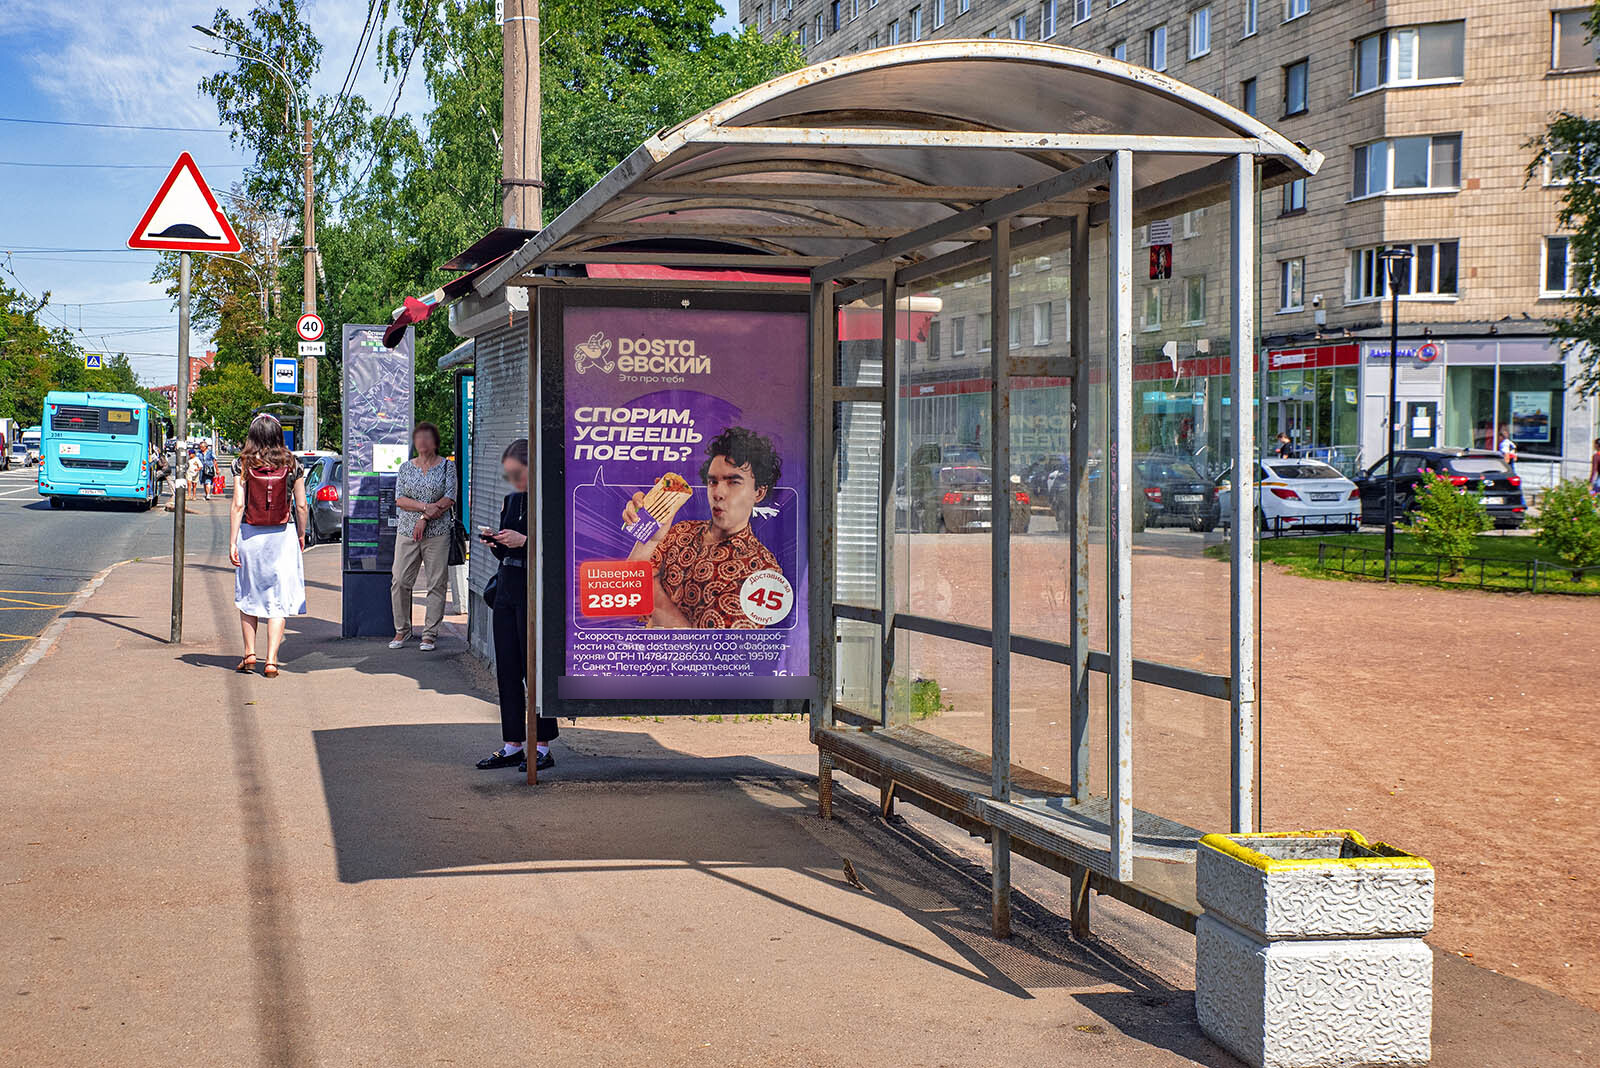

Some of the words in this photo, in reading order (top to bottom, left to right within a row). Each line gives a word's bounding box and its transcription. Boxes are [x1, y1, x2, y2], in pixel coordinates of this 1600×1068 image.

[302, 321, 318, 332] 40
[619, 373, 638, 382] Это
[640, 375, 659, 384] про
[661, 375, 685, 384] тебя
[574, 406, 695, 427] СПОРИМ,
[573, 425, 703, 443] УСПЕЕШЬ
[573, 444, 692, 462] ПОЕСТЬ?
[587, 568, 645, 580] Шаверма
[588, 580, 642, 589] классика
[747, 587, 784, 611] 45
[626, 633, 670, 641] доставки
[672, 633, 710, 641] зависит
[712, 633, 722, 641] от
[745, 632, 787, 642] подроб-
[573, 643, 602, 651] ности
[603, 643, 615, 651] на
[617, 642, 645, 651] сайте
[646, 642, 712, 653] dostaevsky.ru
[713, 642, 738, 651] ООО
[573, 653, 605, 662] кухня»
[607, 652, 635, 660] ОГРН
[714, 652, 746, 662] Адрес:
[573, 663, 580, 671] г.
[671, 662, 751, 673] Кондратьевский
